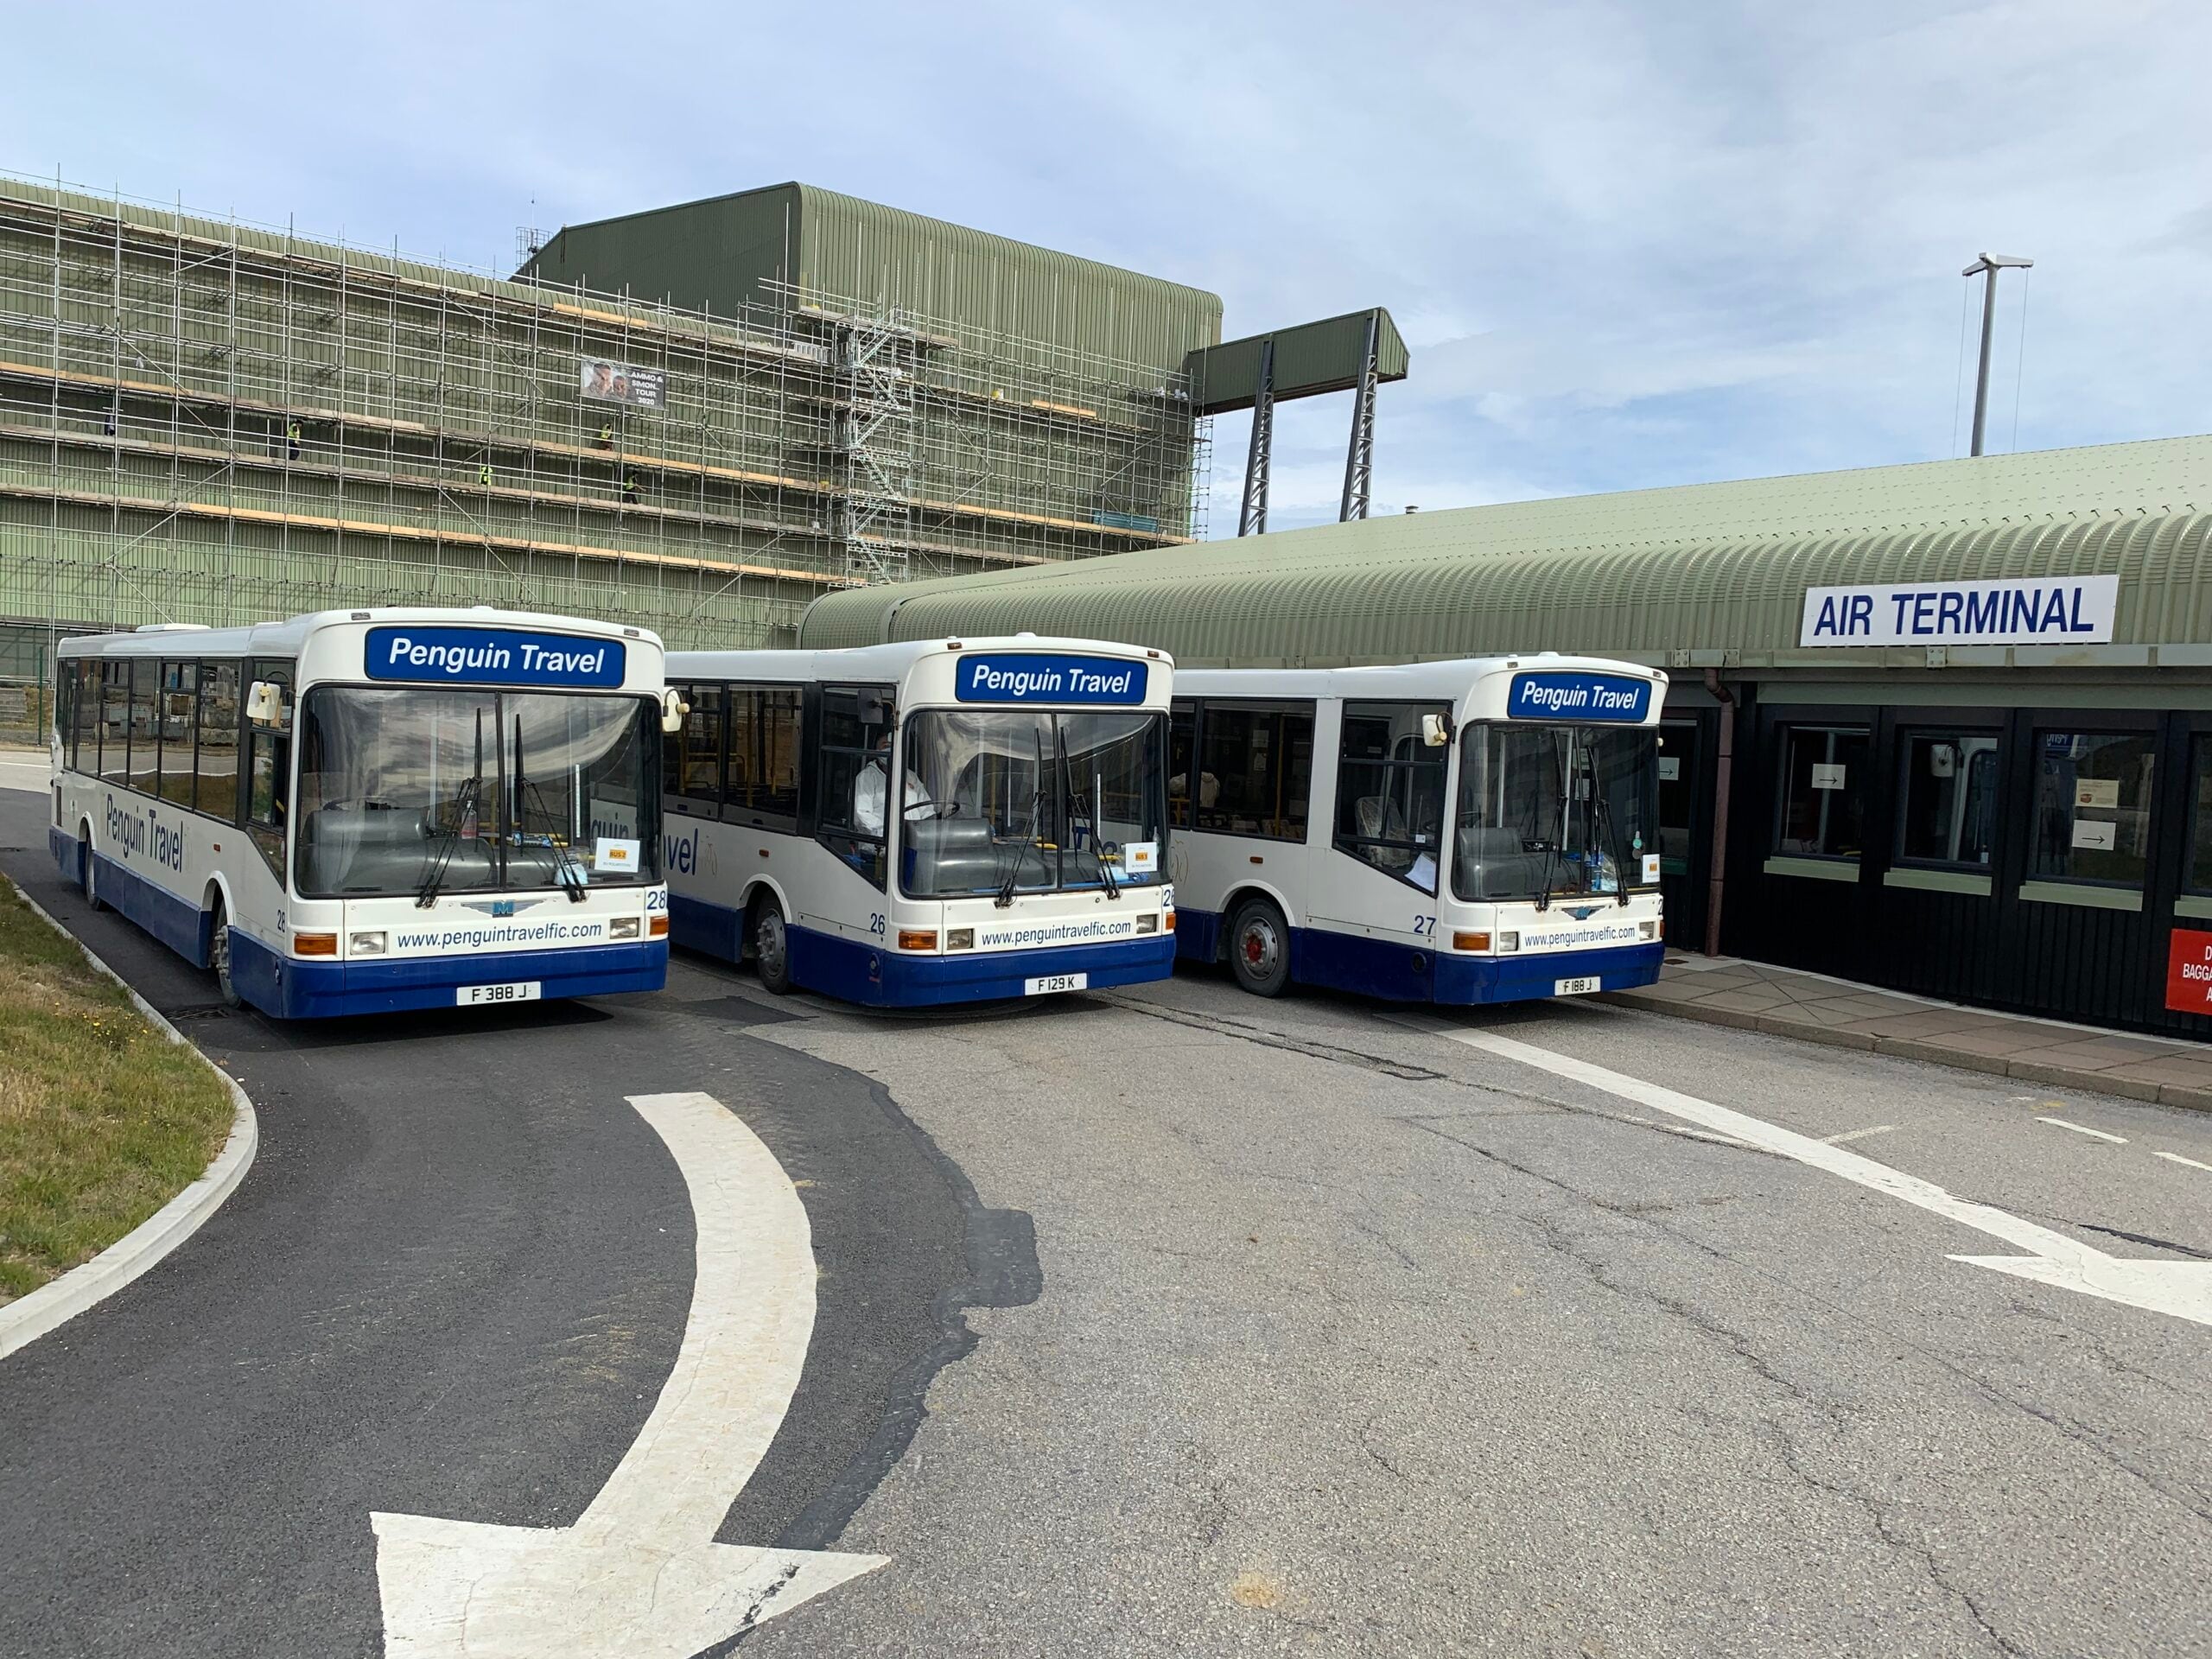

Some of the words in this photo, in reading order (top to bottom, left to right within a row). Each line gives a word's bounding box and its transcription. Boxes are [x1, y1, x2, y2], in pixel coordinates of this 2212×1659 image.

[635, 388, 657, 397] TOUR
[638, 397, 655, 405] 2020
[1813, 594, 1873, 637] AIR
[1891, 587, 2094, 636] TERMINAL
[389, 637, 511, 674] Penguin
[520, 644, 605, 674] Travel
[972, 664, 1062, 696] Penguin
[1069, 669, 1131, 693] Travel
[1521, 681, 1588, 711] Penguin
[1592, 685, 1640, 709] Travel
[106, 793, 144, 859] Penguin
[149, 809, 183, 873] Travel
[647, 890, 666, 910] 28
[276, 909, 286, 933] 28
[870, 912, 886, 935] 26
[1414, 915, 1437, 936] 27
[397, 923, 602, 950] www.penguintravelfic.com
[982, 920, 1131, 947] www.penguintravelfic.com
[1524, 925, 1636, 948] www.penguintravelfic.com
[472, 988, 481, 1001] F
[486, 986, 514, 1001] 388
[518, 984, 527, 998] J
[1039, 980, 1045, 992] F
[1048, 977, 1065, 991] 129
[1068, 976, 1075, 988] K
[1563, 981, 1570, 993] F
[1571, 980, 1584, 992] 188
[1586, 979, 1592, 990] J
